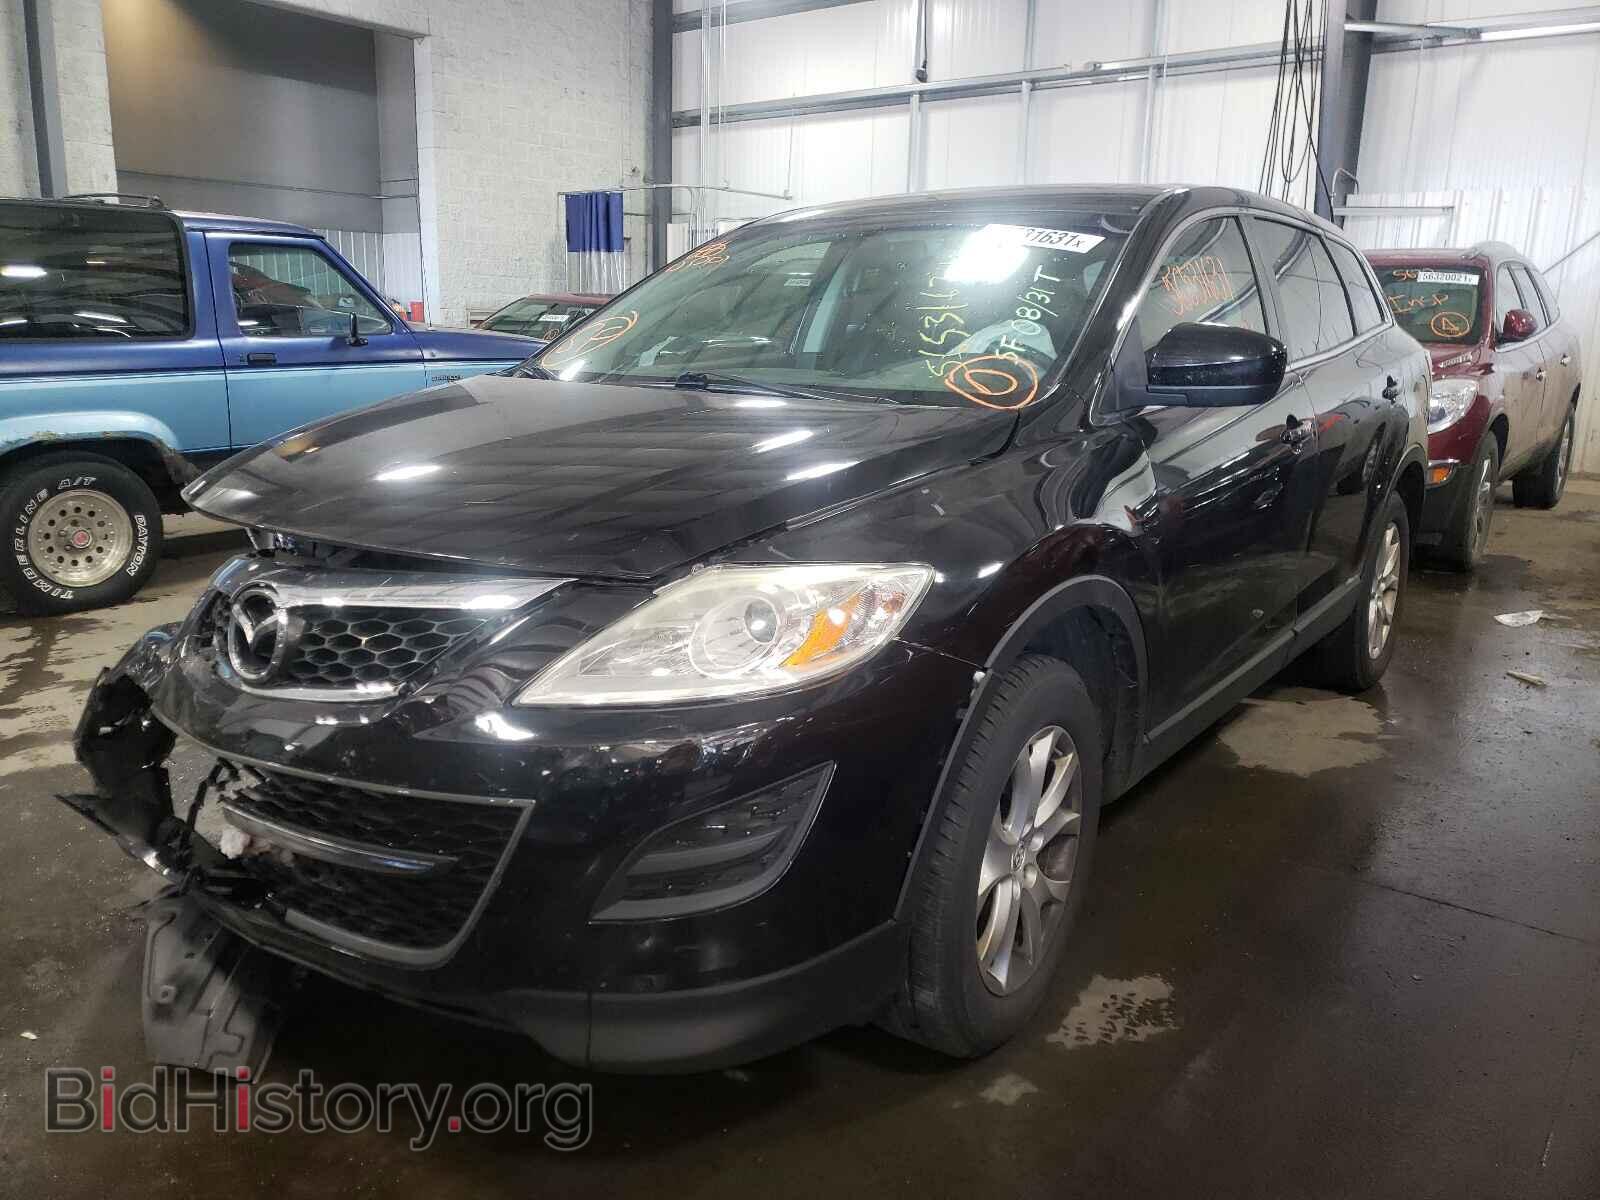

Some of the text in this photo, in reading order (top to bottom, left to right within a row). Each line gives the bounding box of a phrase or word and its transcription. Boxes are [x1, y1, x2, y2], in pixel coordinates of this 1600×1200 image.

[14, 476, 97, 600] TIMBERLINE A/T
[126, 514, 149, 577] DAYTON
